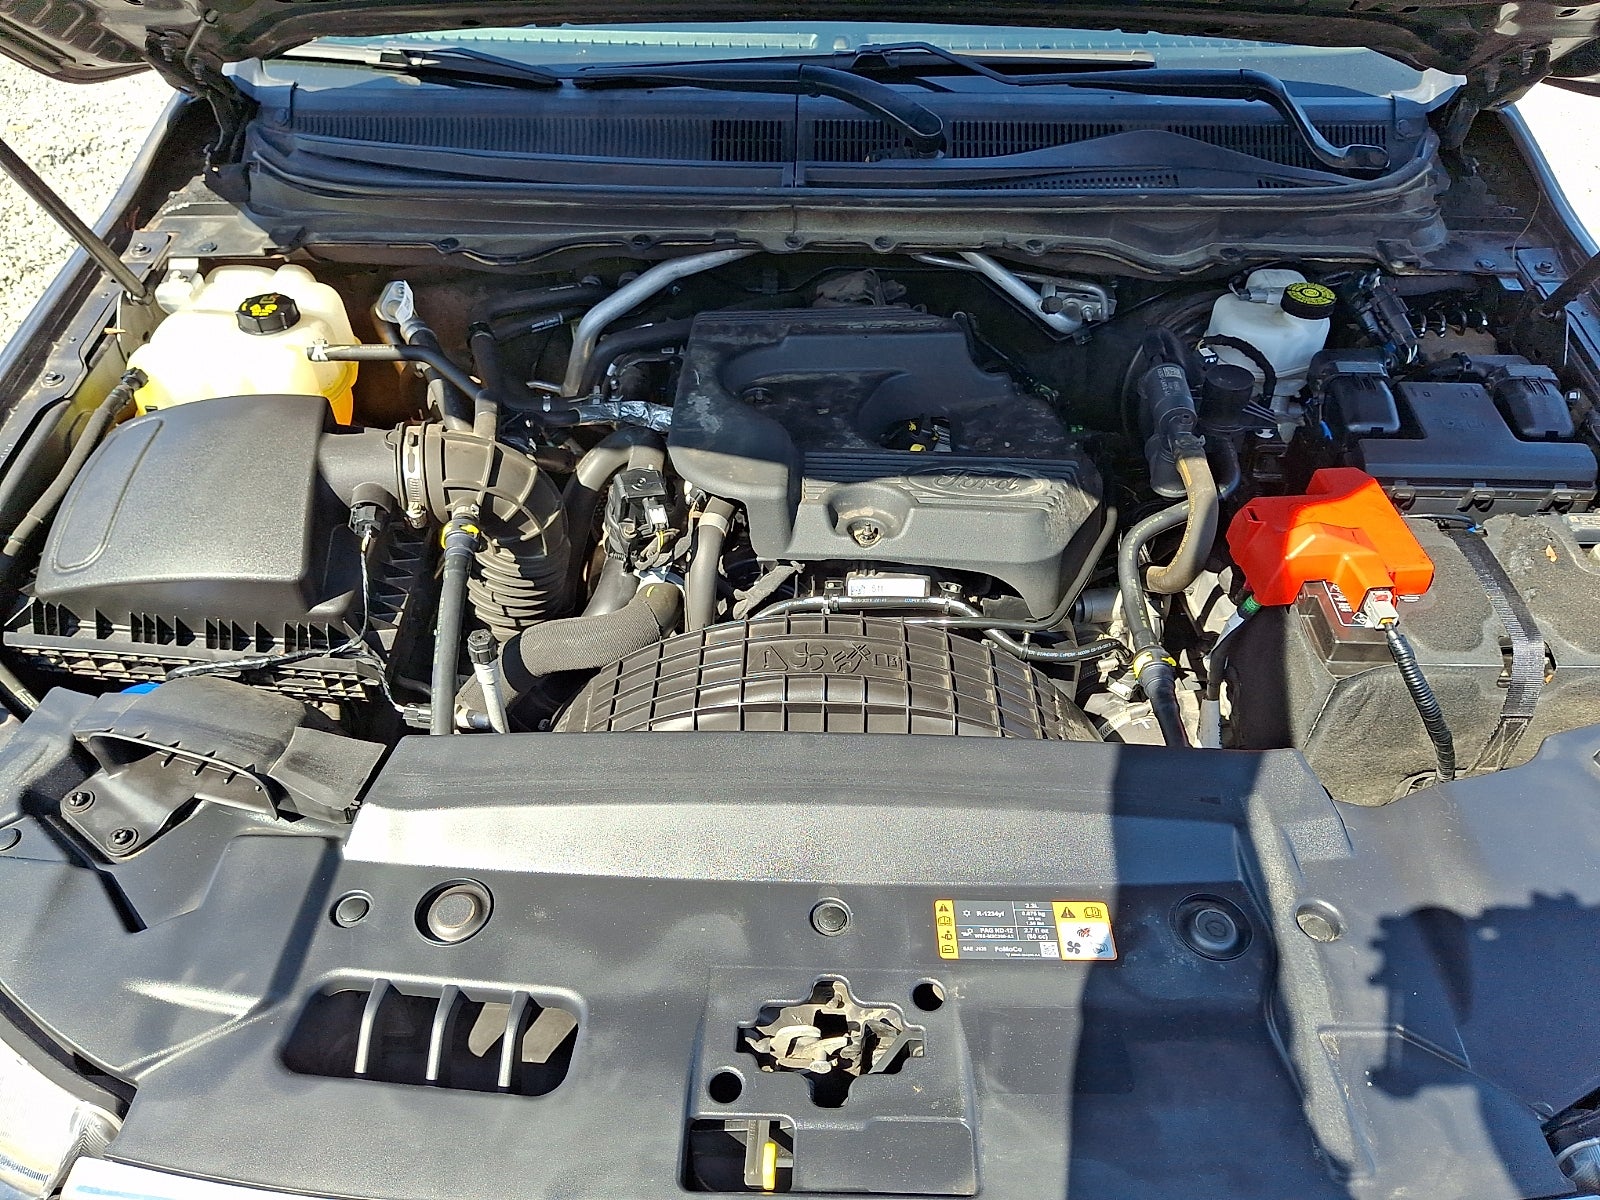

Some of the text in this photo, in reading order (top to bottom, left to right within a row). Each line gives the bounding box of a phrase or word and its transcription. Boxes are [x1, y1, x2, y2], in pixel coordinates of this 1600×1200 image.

[933, 469, 1020, 492] Ford
[976, 910, 1005, 918] R-1234yf
[994, 945, 1023, 953] FoMoCo
